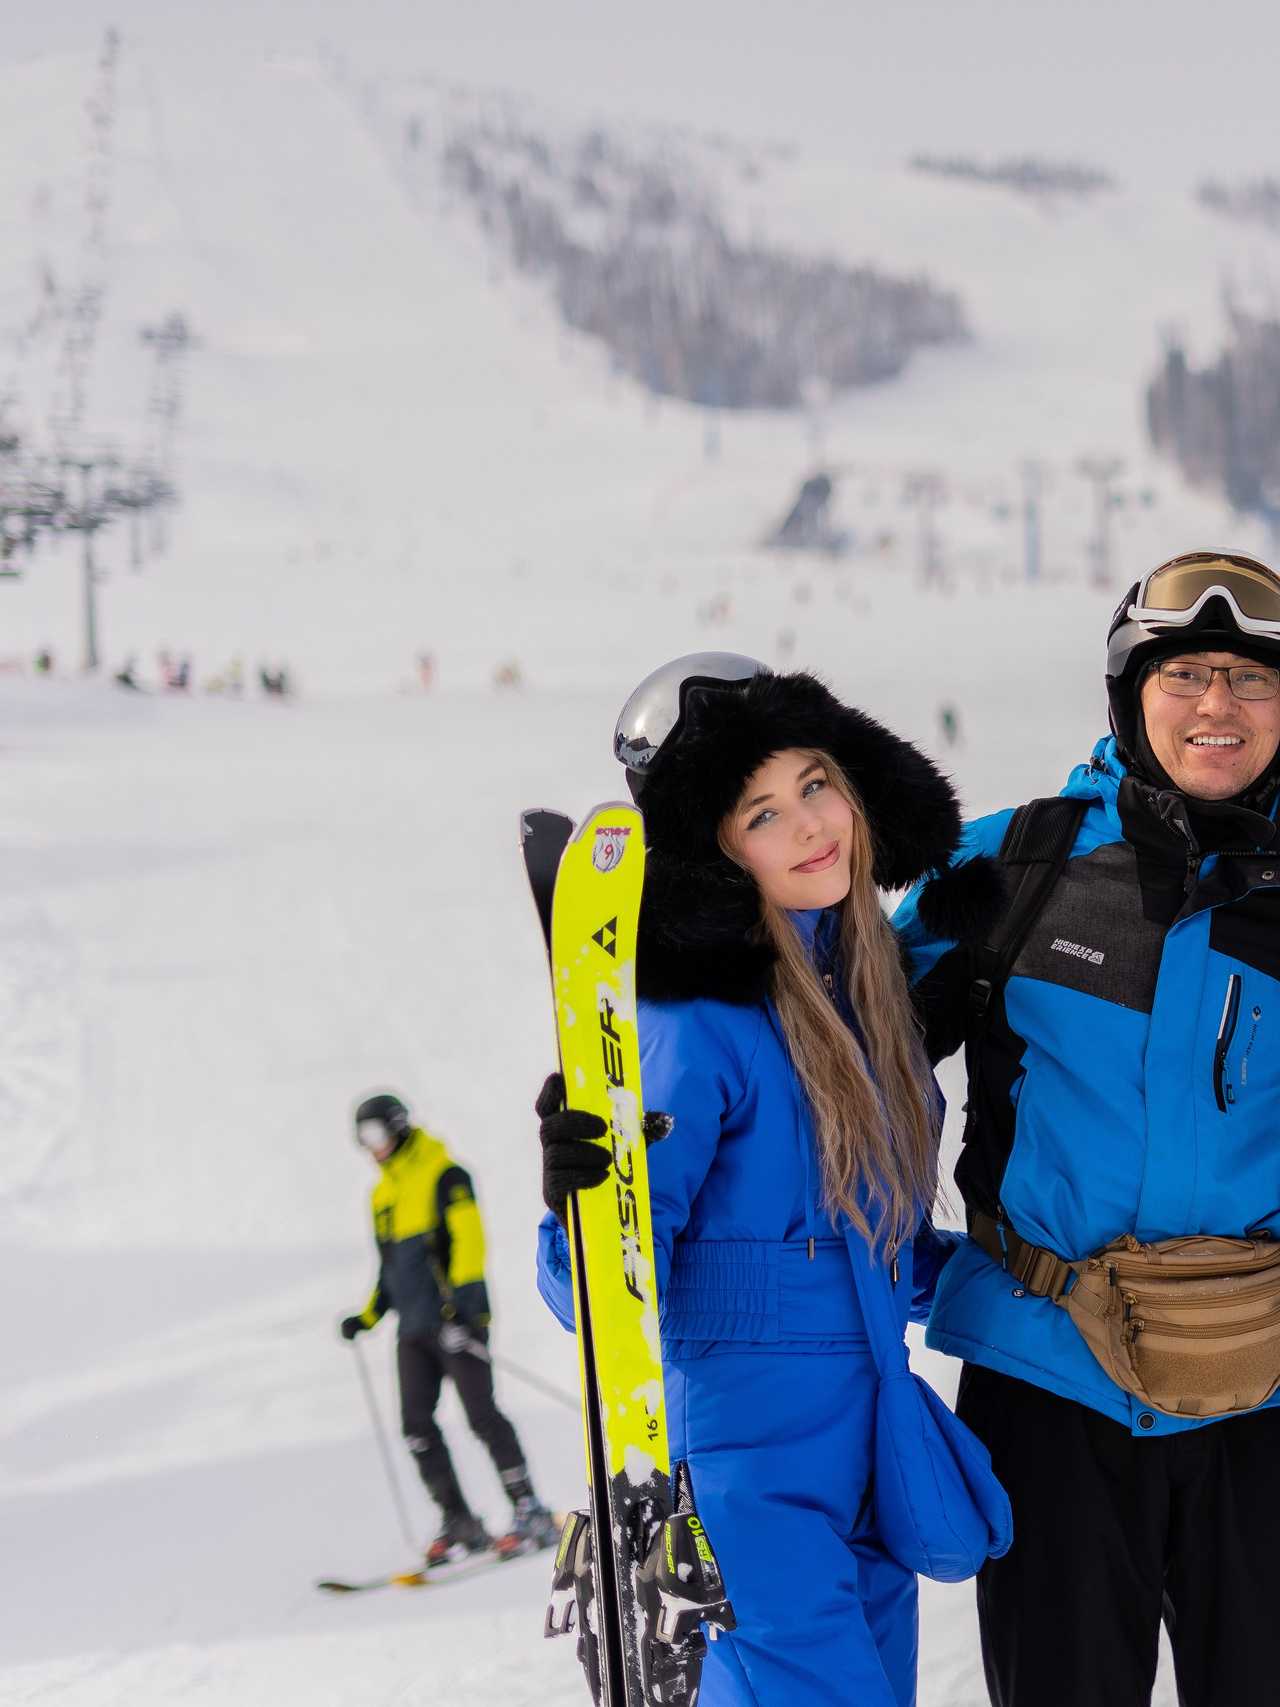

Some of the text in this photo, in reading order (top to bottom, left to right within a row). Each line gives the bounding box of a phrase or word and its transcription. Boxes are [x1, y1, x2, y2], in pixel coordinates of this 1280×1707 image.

[1050, 943, 1089, 960] ERIENCE
[1053, 938, 1093, 954] HIGHEXP
[665, 1522, 676, 1574] FISCHER
